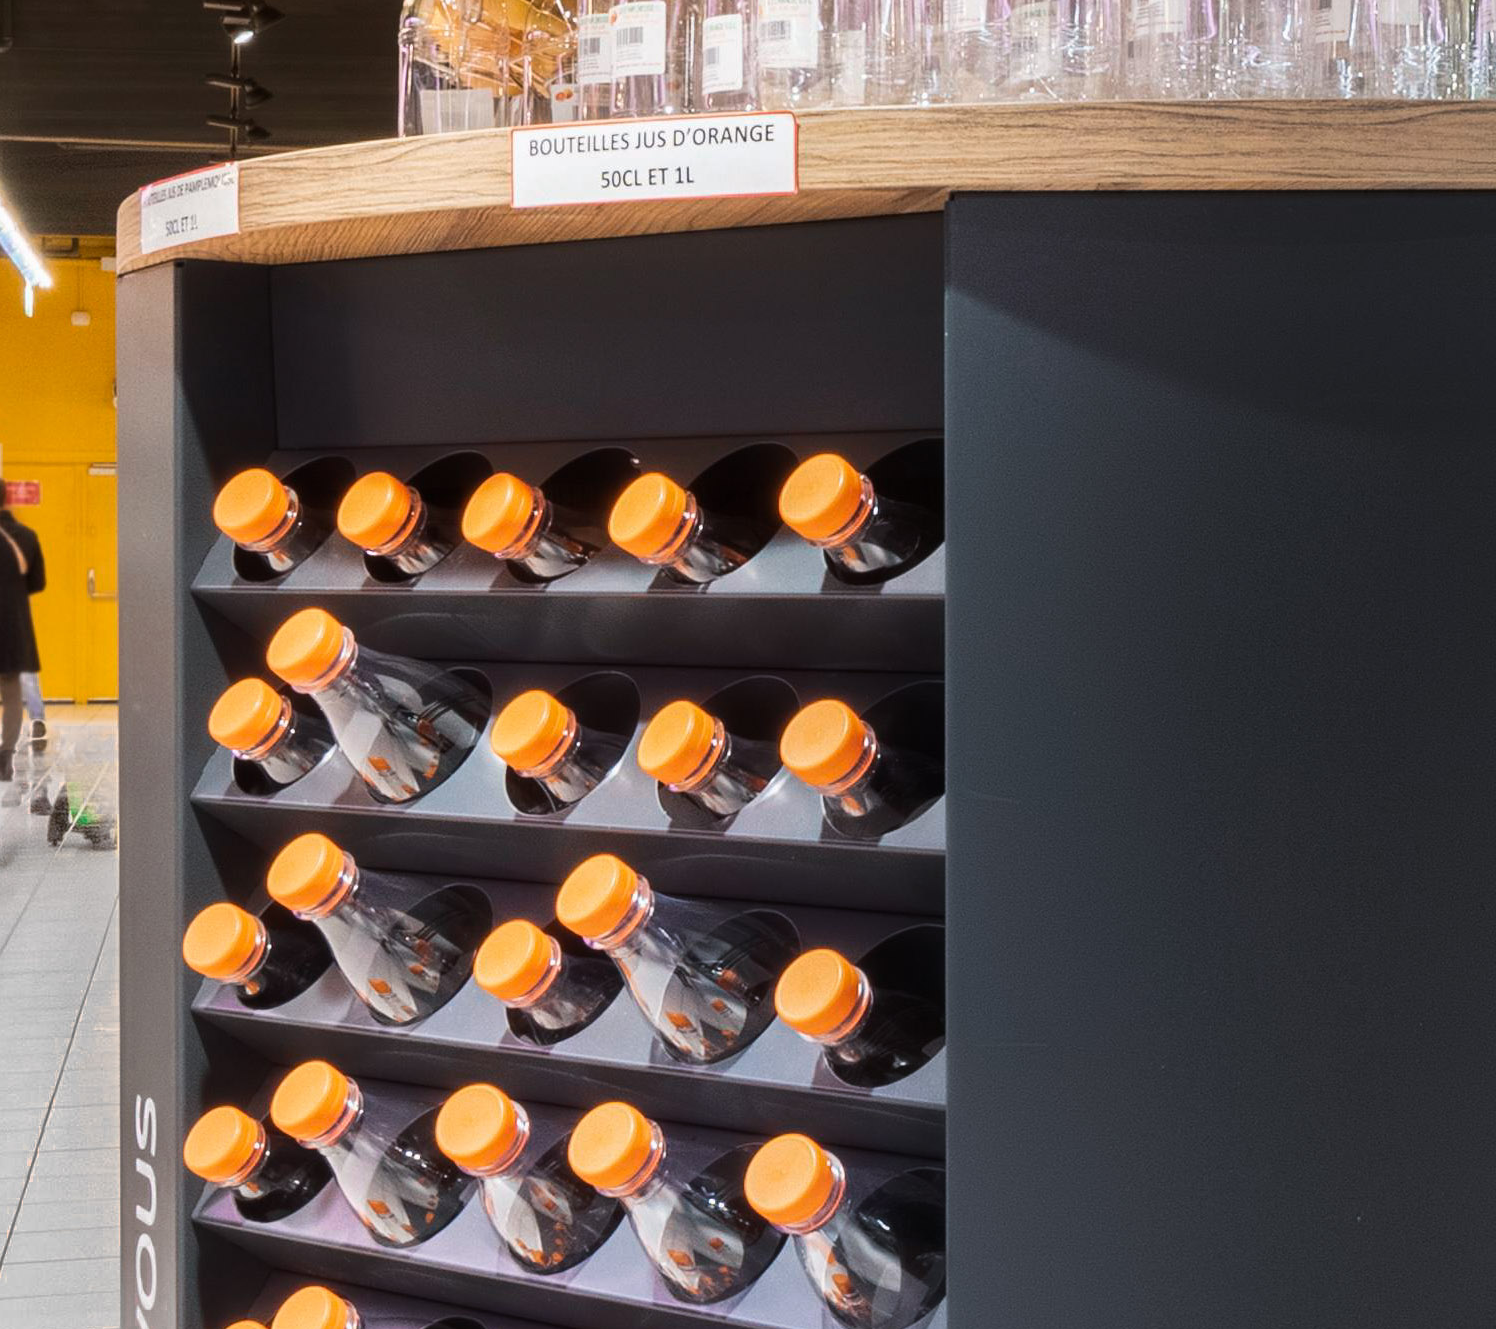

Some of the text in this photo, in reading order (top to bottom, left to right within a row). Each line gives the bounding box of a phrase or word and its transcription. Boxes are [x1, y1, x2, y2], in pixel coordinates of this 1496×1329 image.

[529, 124, 775, 156] BOUTEILLES JUS D'ORANGE
[601, 166, 695, 189] 50CL ET 1L
